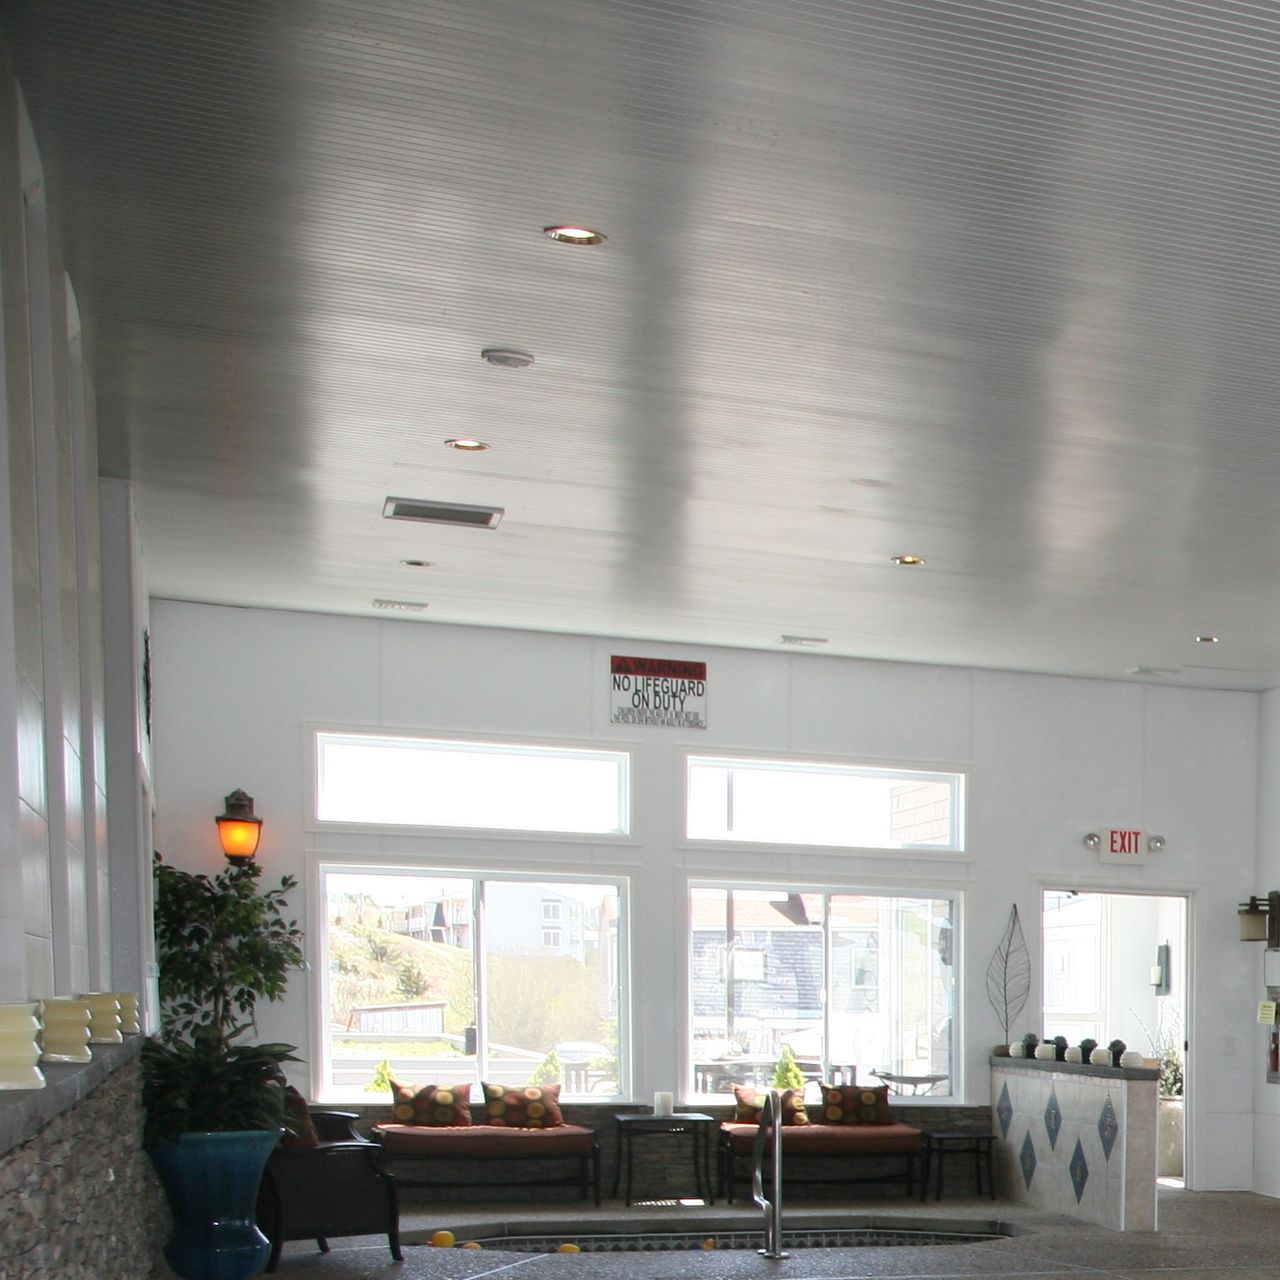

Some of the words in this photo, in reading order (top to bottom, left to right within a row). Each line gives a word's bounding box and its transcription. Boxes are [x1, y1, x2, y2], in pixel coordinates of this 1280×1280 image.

[636, 661, 703, 678] WARNING
[613, 675, 631, 692] NO
[635, 677, 704, 696] LIFEGUARD
[632, 693, 649, 708] ON
[654, 694, 686, 712] DUTY
[1111, 831, 1141, 854] EXIT
